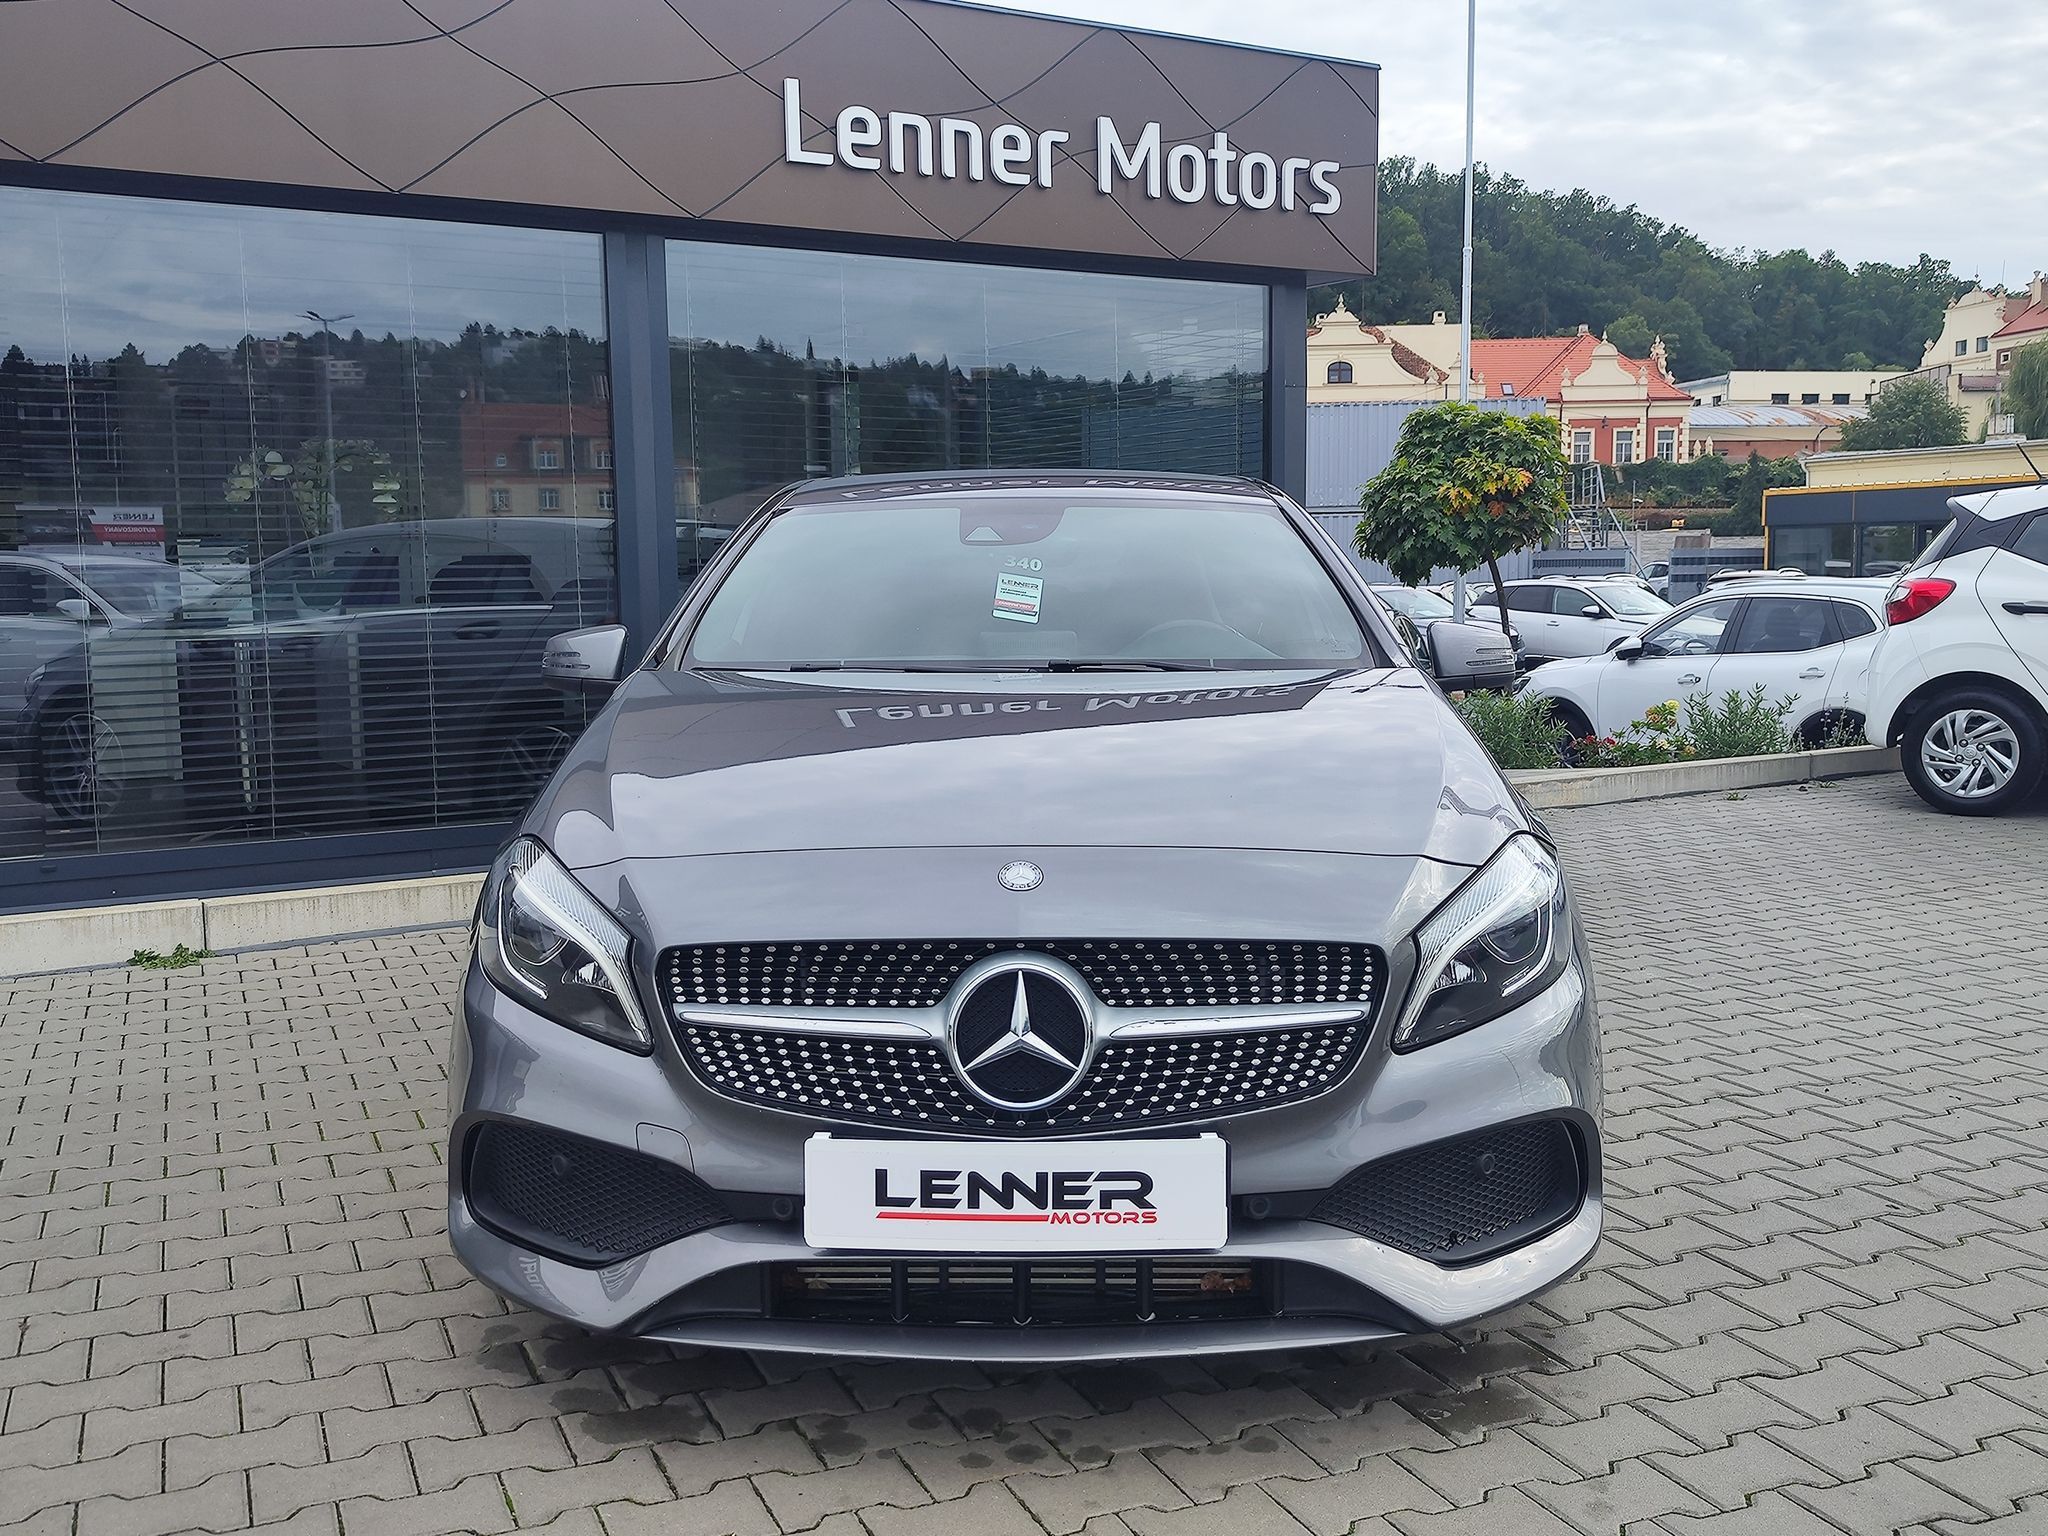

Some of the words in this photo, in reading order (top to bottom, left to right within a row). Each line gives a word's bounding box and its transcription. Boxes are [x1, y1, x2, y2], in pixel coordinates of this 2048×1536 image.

[783, 77, 1069, 189] Lenner
[1097, 115, 1342, 215] Motors
[1004, 555, 1043, 571] 340
[874, 1168, 1158, 1210] LENNER
[1049, 1211, 1158, 1225] MOTORS
